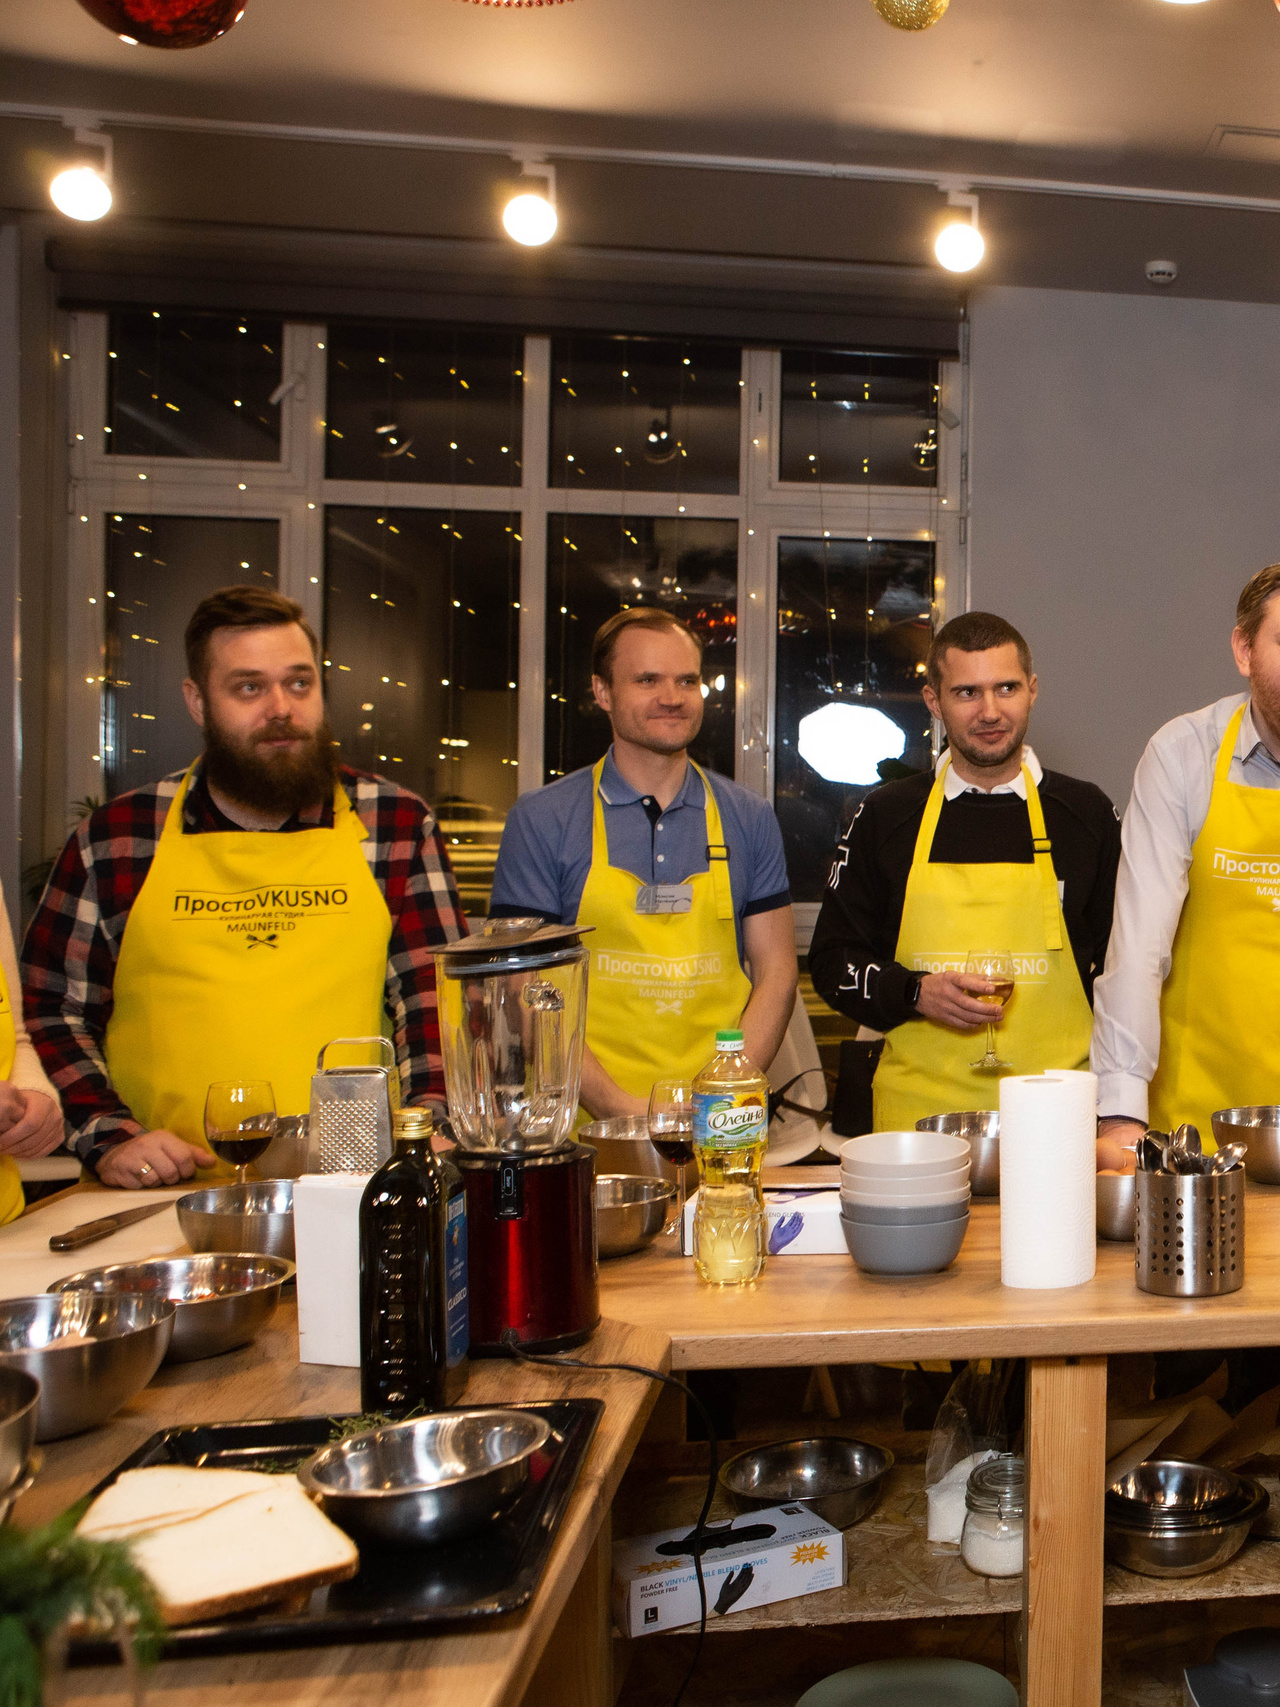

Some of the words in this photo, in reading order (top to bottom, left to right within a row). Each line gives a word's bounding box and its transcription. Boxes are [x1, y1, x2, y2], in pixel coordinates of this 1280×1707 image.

[173, 888, 348, 915] ПростоVKUSNO
[226, 921, 296, 933] MAUNFELD
[597, 954, 721, 978] ПростоVKUSNO
[638, 988, 695, 999] MAUNFELD
[712, 1107, 764, 1129] Олейна
[640, 1581, 664, 1592] BLACK
[664, 1569, 716, 1586] VINYL/NIRILE
[717, 1563, 740, 1574] BLEND
[741, 1557, 768, 1570] GLOVES
[640, 1589, 665, 1599] POWDER
[665, 1585, 678, 1594] FREE
[648, 1608, 655, 1618] L
